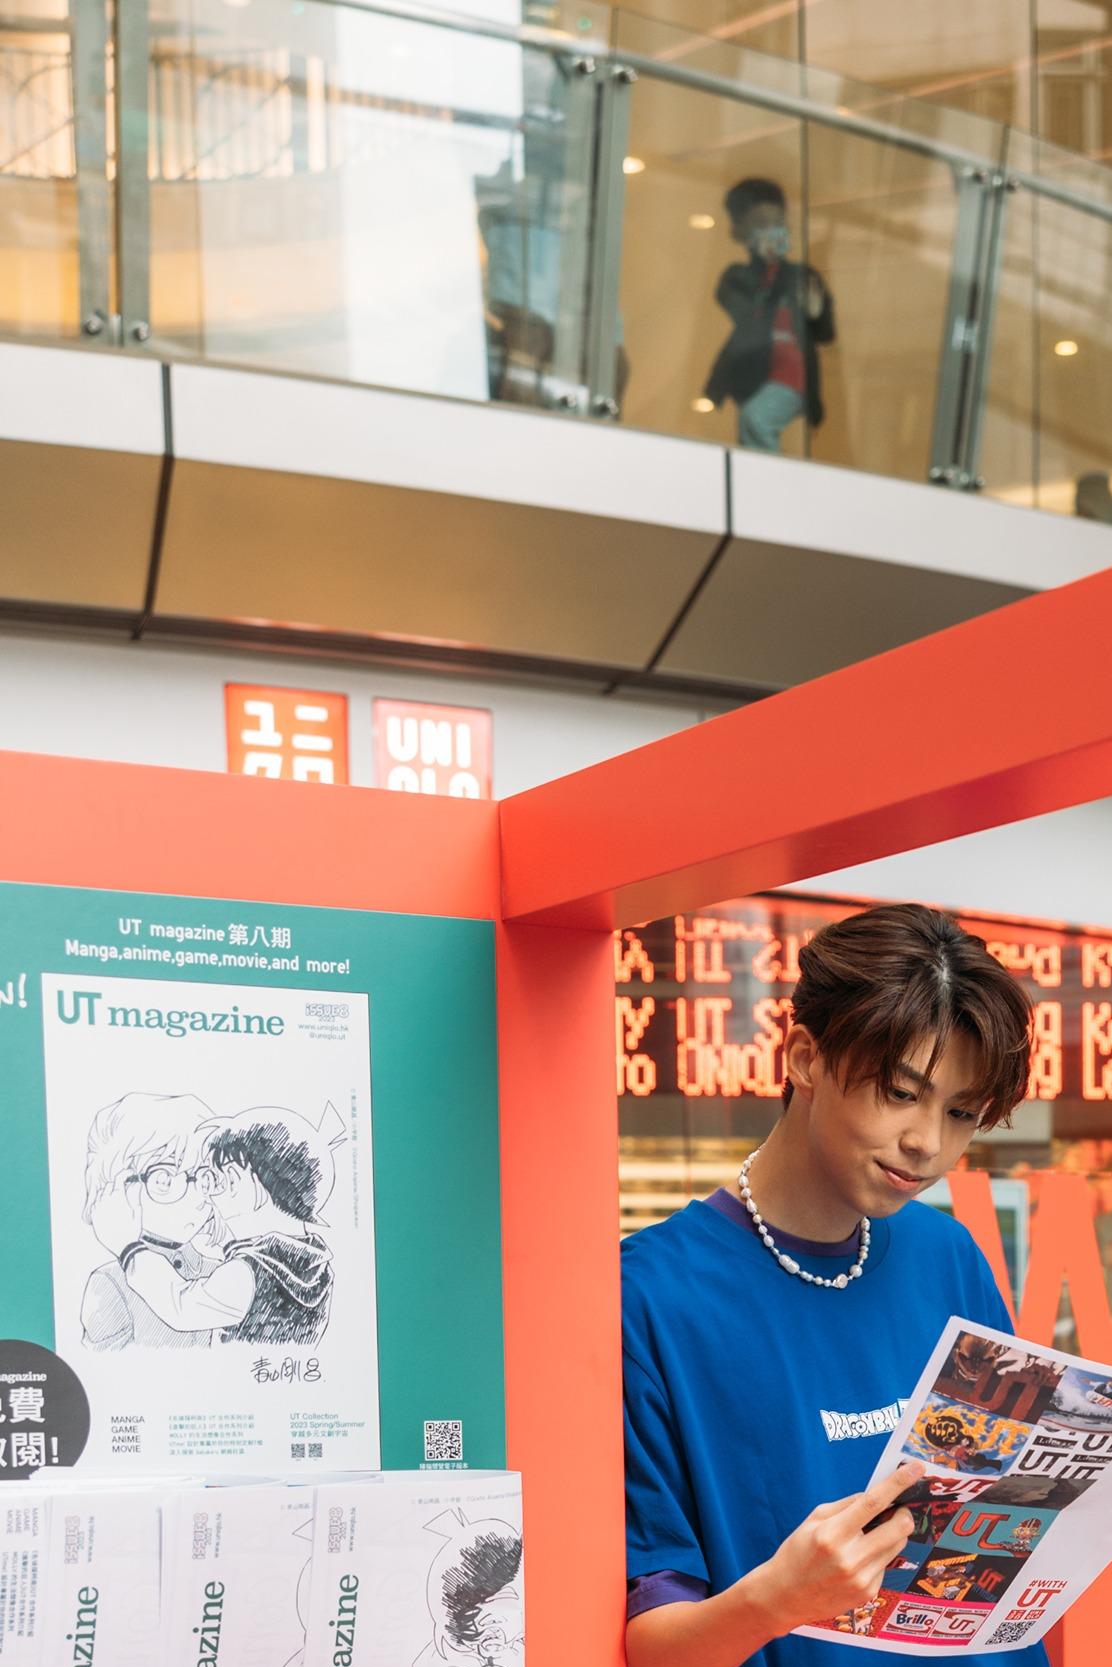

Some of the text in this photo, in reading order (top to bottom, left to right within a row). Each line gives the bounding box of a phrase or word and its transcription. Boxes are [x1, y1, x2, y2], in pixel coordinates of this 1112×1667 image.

[241, 700, 333, 752] ユニ
[387, 717, 471, 768] UNI
[119, 918, 291, 949] UT magazine 第八期
[307, 960, 350, 974] more!
[57, 990, 285, 1038] UT magazine
[677, 1042, 789, 1097] UNIQL
[0, 1371, 47, 1384] agazine
[110, 1415, 145, 1424] MANGA
[289, 1412, 339, 1421] UT Collection
[111, 1425, 139, 1434] GAME
[290, 1421, 365, 1430] 2023 Spring/Summer
[111, 1435, 141, 1444] ANIME
[112, 1444, 141, 1453] MOVIE
[1018, 1449, 1069, 1472] UT
[952, 1509, 1011, 1551] UT
[1029, 1580, 1067, 1589] #WITH
[1017, 1588, 1061, 1607] UT
[896, 1612, 934, 1627] Brillo
[949, 1618, 975, 1631] UT
